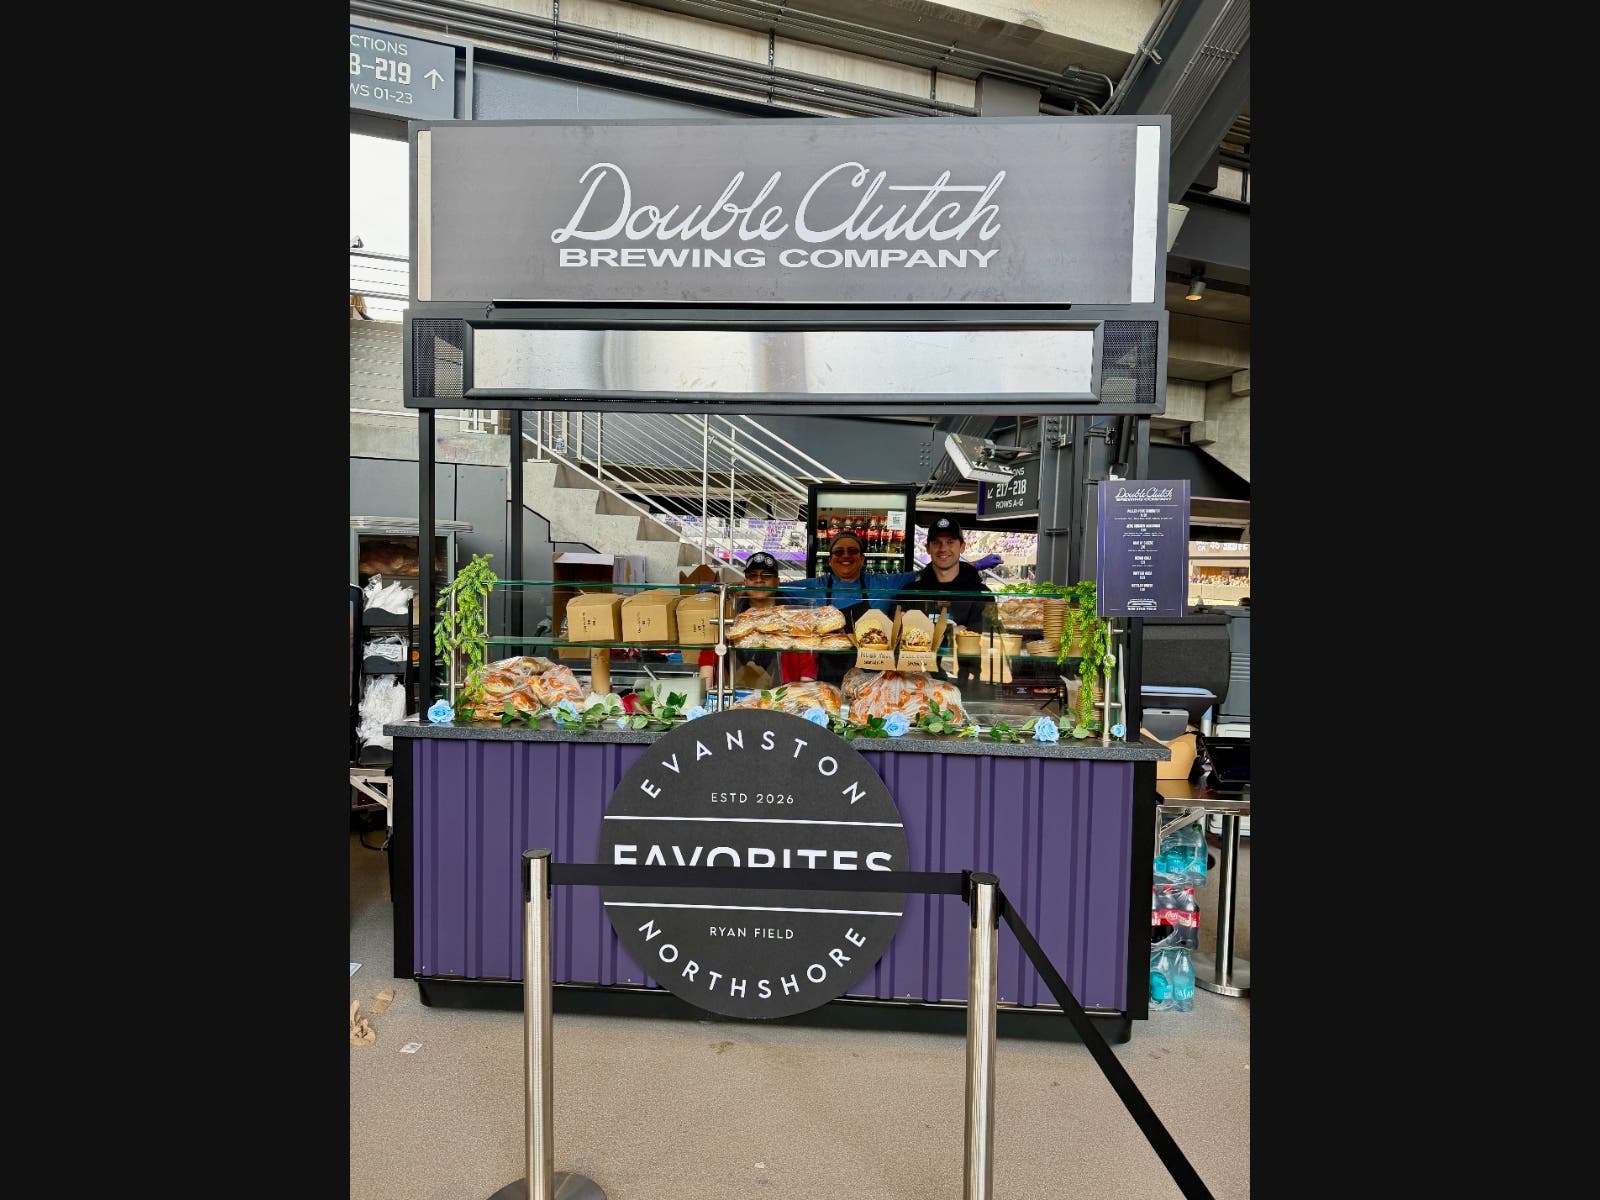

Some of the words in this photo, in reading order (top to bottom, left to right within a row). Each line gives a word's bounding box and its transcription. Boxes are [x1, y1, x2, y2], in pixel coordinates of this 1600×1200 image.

[373, 87, 413, 105] 01-23
[551, 163, 789, 243] Double
[795, 162, 1006, 243] Clutch
[559, 248, 766, 268] BREWING
[779, 248, 1000, 268] COMPANY
[995, 479, 1027, 498] 217-218
[1115, 487, 1147, 498] Double
[1146, 486, 1174, 498] Clutch
[995, 500, 1012, 509] ROWS
[1013, 498, 1024, 507] A-G
[640, 730, 867, 804] EVANSTON
[711, 792, 748, 803] ESTD
[756, 793, 795, 804] 2026
[614, 844, 893, 872] FAVORITES
[710, 926, 747, 938] RYAN
[754, 927, 795, 939] FIELD
[638, 919, 867, 999] NORTHSHORE
